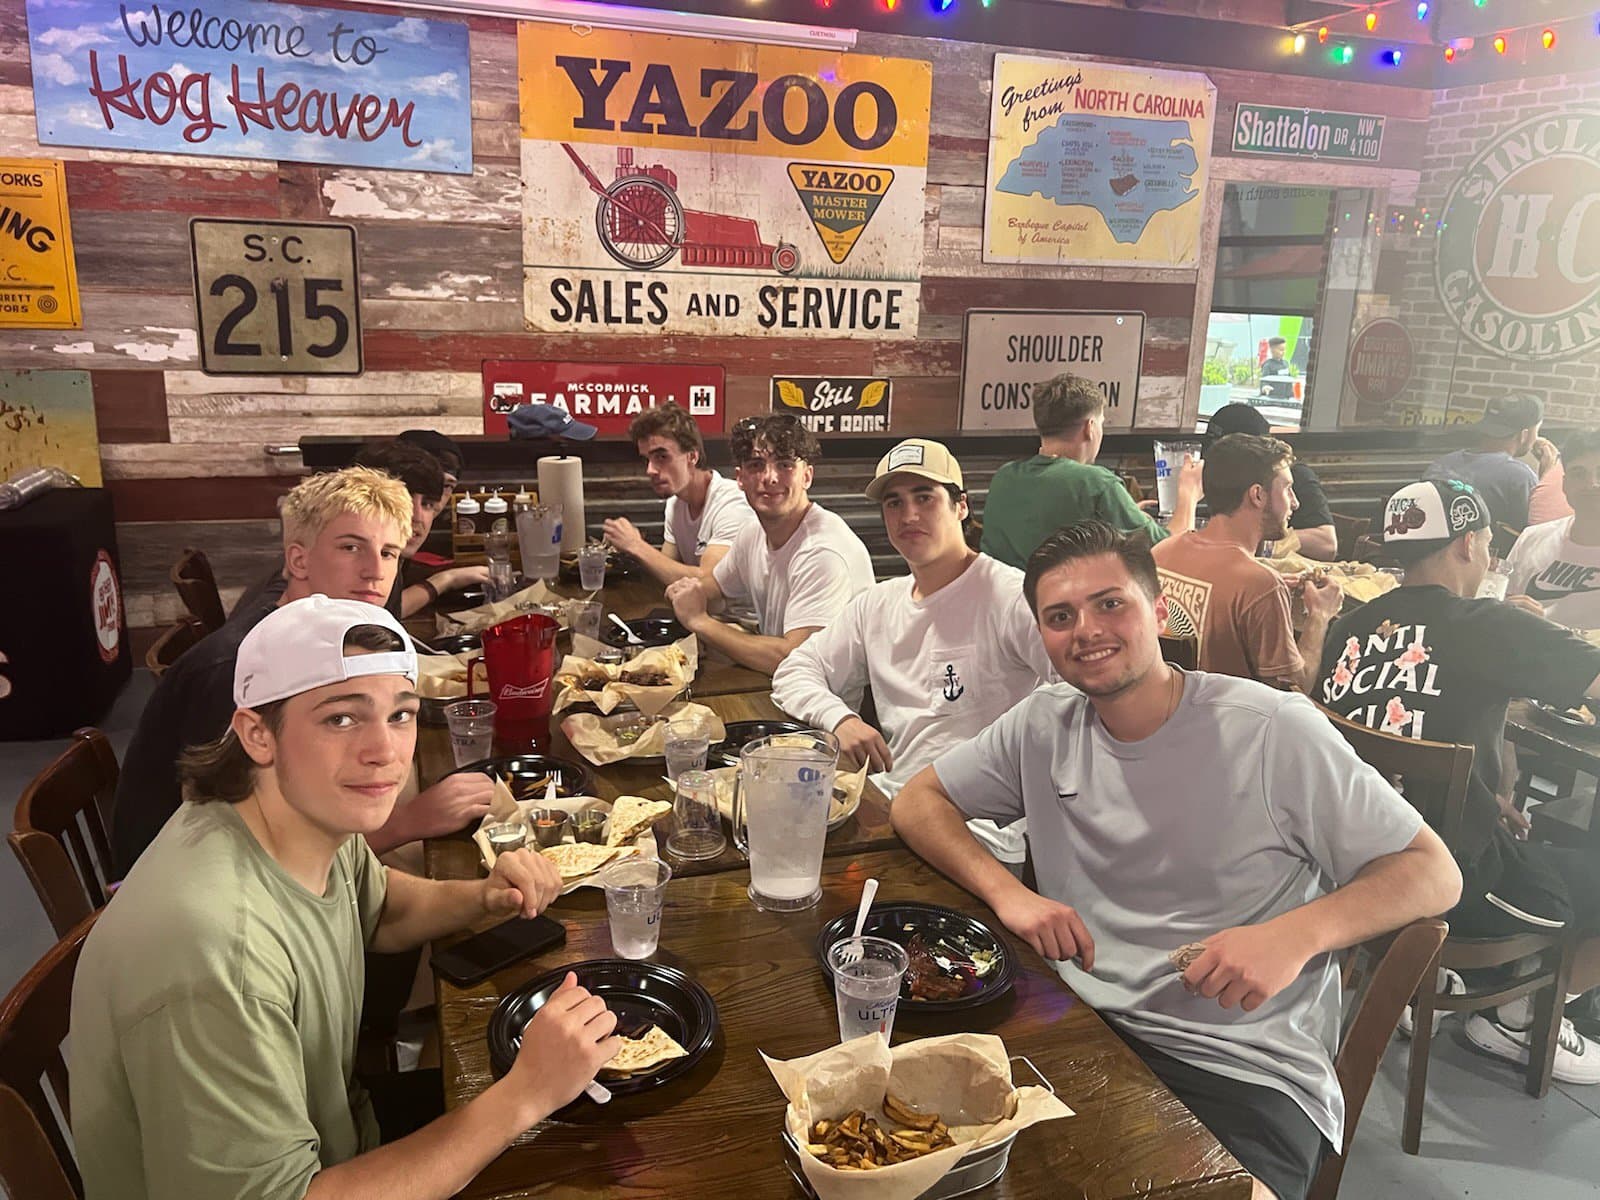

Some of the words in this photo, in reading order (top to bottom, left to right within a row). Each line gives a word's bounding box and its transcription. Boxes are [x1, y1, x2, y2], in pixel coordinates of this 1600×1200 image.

[120, 3, 313, 57] Welcome
[328, 26, 388, 65] to
[89, 50, 226, 142] Hog
[227, 64, 422, 147] Heaven
[555, 55, 897, 150] YAZOO
[1001, 69, 1083, 116] Greetings
[1022, 100, 1064, 132] from
[1074, 88, 1129, 113] NORTH
[1133, 93, 1205, 119] CAROLINA
[1237, 110, 1330, 151] Shattalon
[1334, 128, 1349, 145] DR
[1358, 118, 1375, 136] NW
[1350, 138, 1378, 157] 4100
[0, 173, 43, 188] ORKS
[801, 170, 882, 192] YAZOO
[812, 195, 868, 209] MASTER
[814, 208, 866, 221] MOWER
[243, 233, 312, 263] S.C.
[209, 273, 349, 358] 215
[549, 277, 669, 326] SALES
[686, 292, 741, 318] AND
[757, 285, 902, 331] SERVICE
[1006, 335, 1103, 363] SHOULDER
[1337, 624, 1426, 663] ANTI
